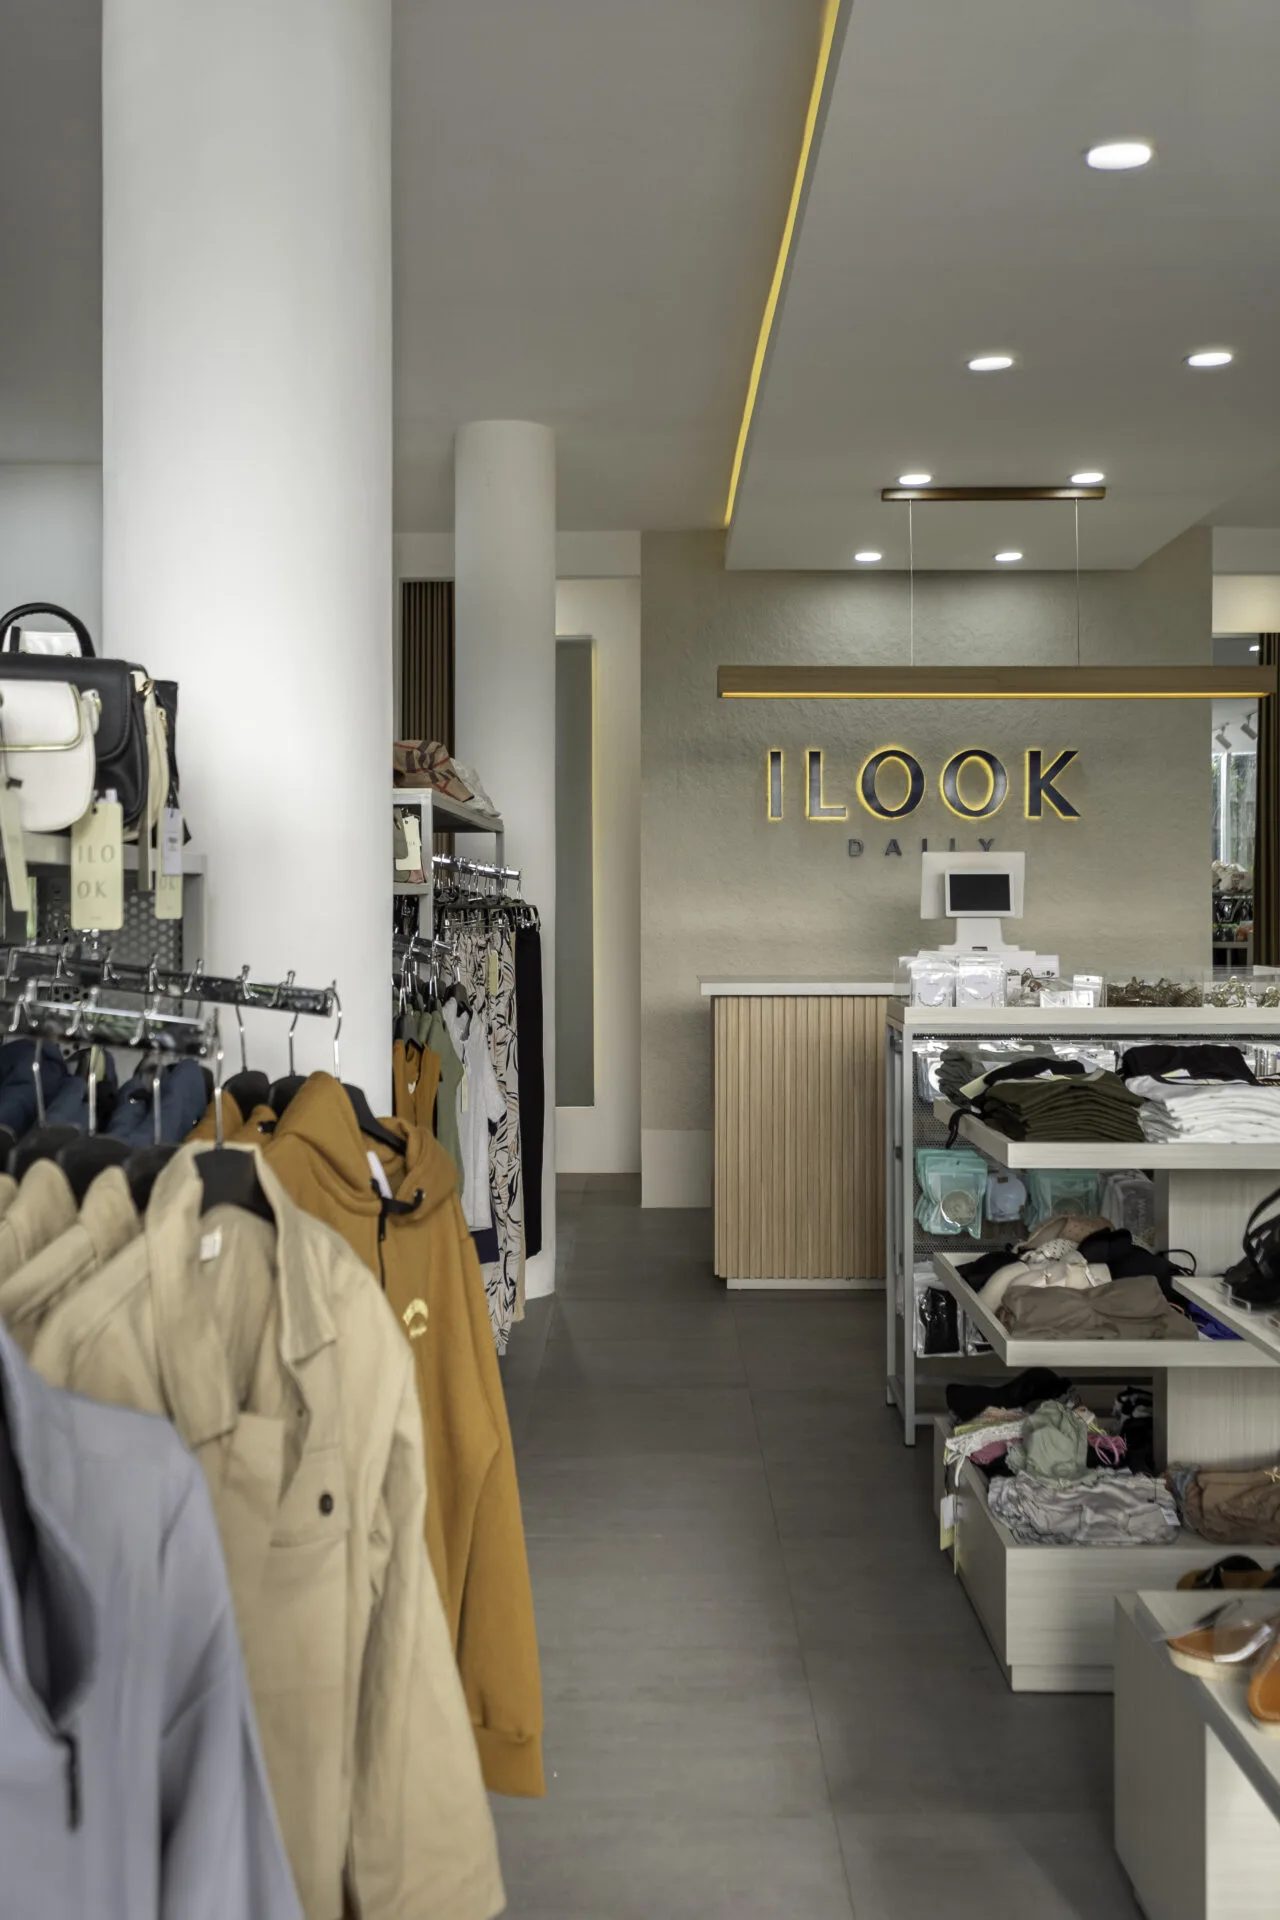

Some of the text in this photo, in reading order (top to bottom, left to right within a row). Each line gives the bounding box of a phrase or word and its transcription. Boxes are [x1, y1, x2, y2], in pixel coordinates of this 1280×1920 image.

[768, 748, 1082, 819] ILOOK
[78, 844, 115, 864] ILO
[77, 880, 108, 899] OK
